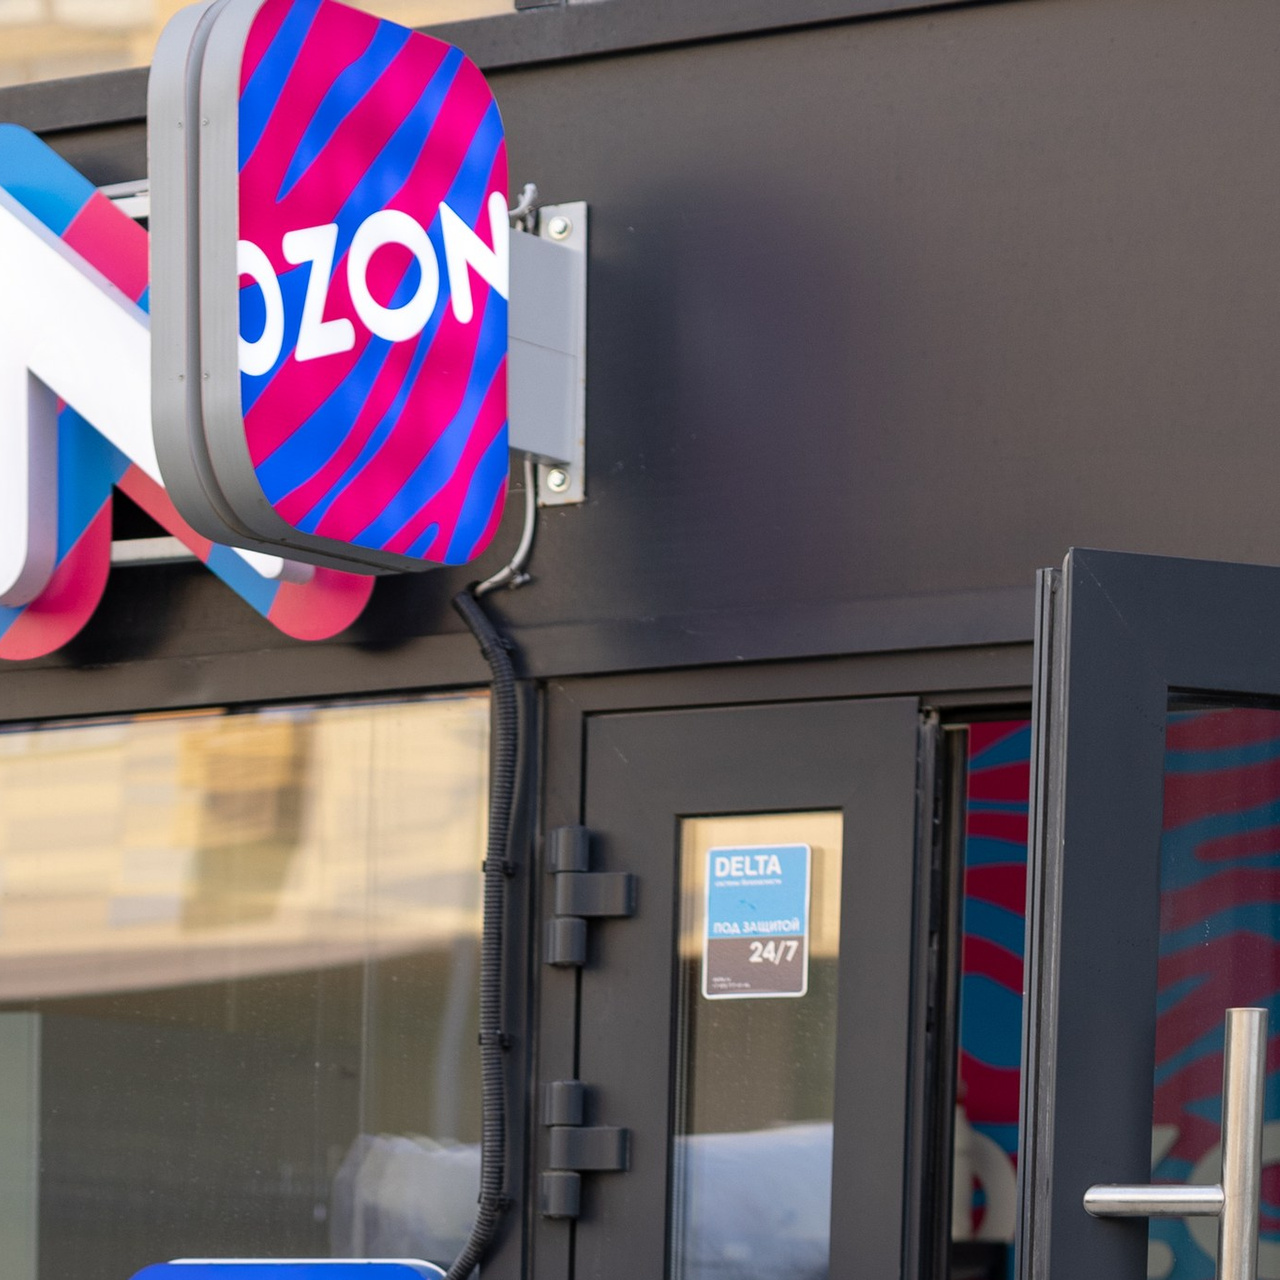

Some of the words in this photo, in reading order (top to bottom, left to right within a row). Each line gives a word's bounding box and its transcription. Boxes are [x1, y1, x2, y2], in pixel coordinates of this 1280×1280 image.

[714, 854, 783, 877] DELTA
[713, 921, 741, 934] ПОД
[742, 917, 800, 933] ЗАЩИТОЙ
[749, 940, 799, 965] 24/7
